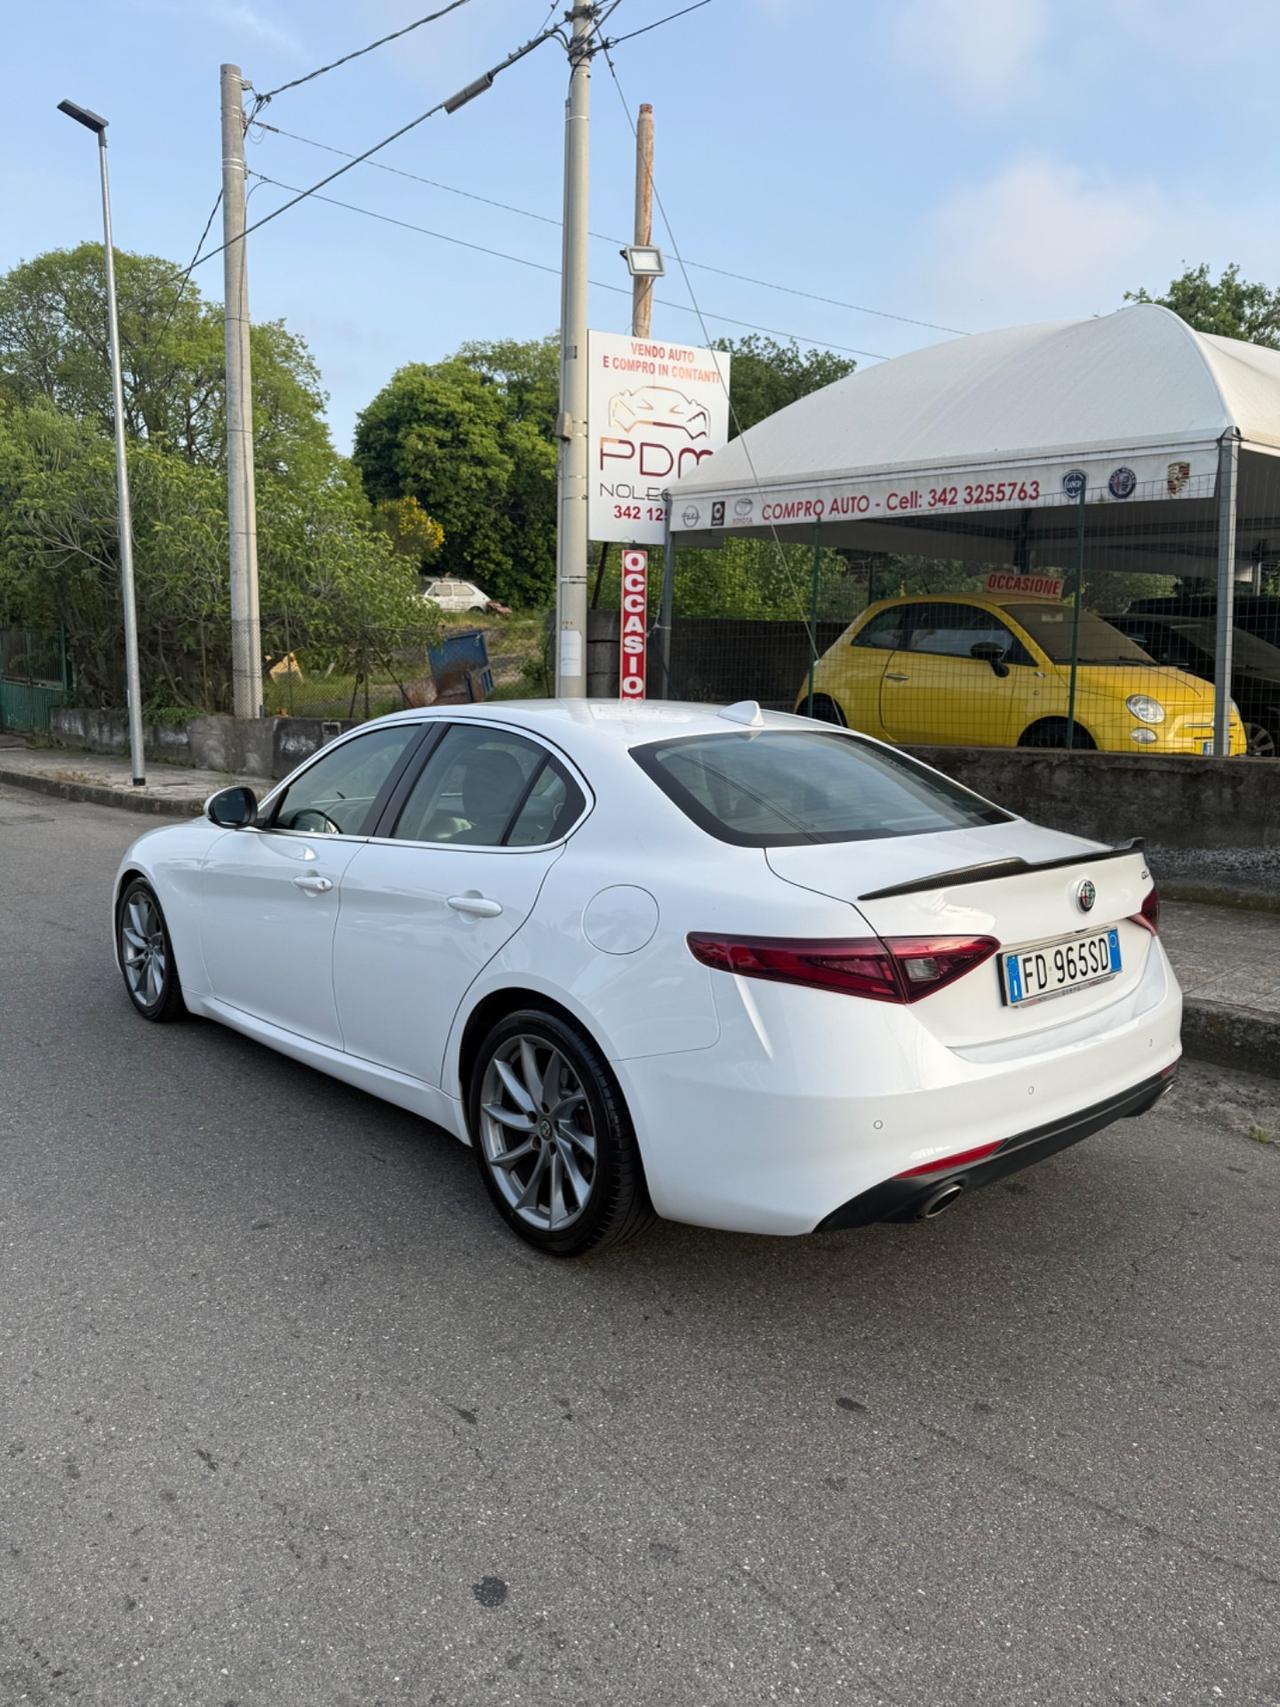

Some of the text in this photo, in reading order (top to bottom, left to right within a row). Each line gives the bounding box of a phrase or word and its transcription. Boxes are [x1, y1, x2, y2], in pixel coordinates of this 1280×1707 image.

[631, 342, 695, 363] VENDO AUTO
[602, 355, 720, 384] E COMPRO IN CONTANTI
[599, 482, 662, 502] NOLE
[762, 499, 825, 520] COMPRO
[829, 495, 870, 515] AUTO
[886, 490, 923, 511] Cell:
[928, 486, 958, 507] 342
[963, 480, 1040, 505] 3255763
[614, 505, 641, 520] 342
[646, 507, 668, 522] 12
[988, 574, 1061, 595] OCCASIONE
[622, 551, 646, 700] OCCASIO
[1022, 937, 1109, 994] FD 965SD
